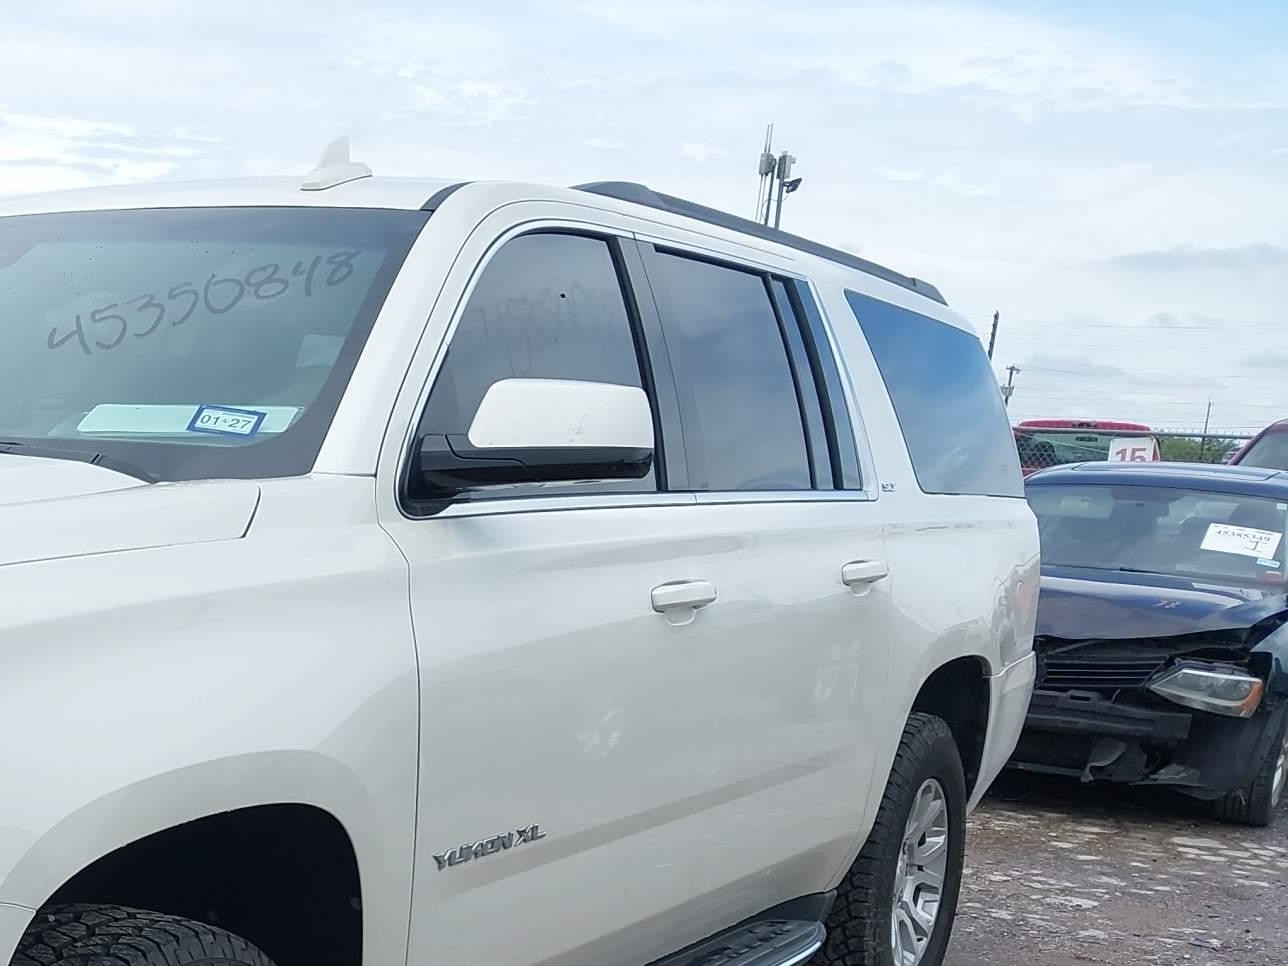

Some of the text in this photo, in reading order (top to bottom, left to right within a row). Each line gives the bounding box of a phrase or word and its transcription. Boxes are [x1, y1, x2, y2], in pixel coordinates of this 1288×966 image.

[47, 249, 361, 355] 45350848
[200, 414, 253, 429] 01 27
[432, 823, 548, 871] YUKON XL
